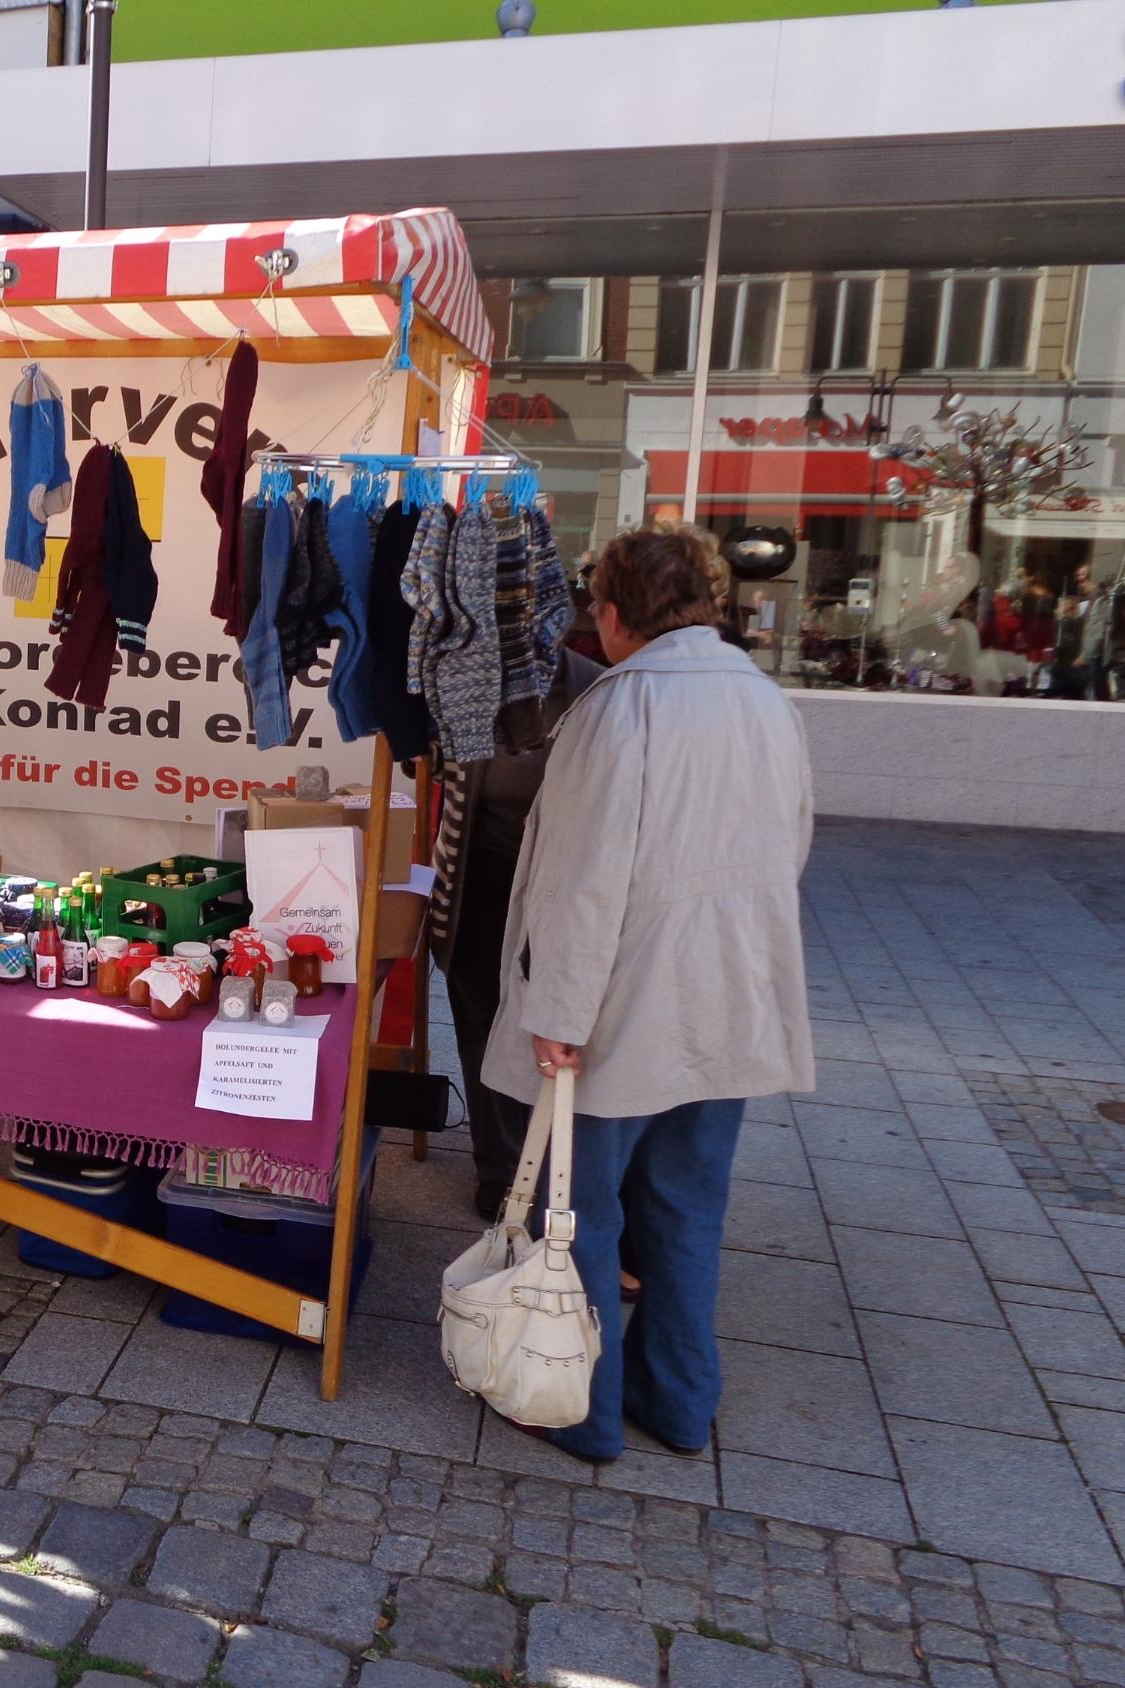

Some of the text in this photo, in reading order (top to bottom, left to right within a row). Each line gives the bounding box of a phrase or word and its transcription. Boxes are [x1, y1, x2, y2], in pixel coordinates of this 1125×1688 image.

[0, 754, 62, 784] für
[74, 760, 139, 792] die
[279, 906, 342, 919] Gemeinsam
[304, 922, 343, 934] Zukunft
[215, 1043, 298, 1056] HOLUNDERGELEE MIT
[213, 1060, 274, 1070] APFELSAFT UND
[212, 1075, 283, 1087] KARAMELISIERTEN
